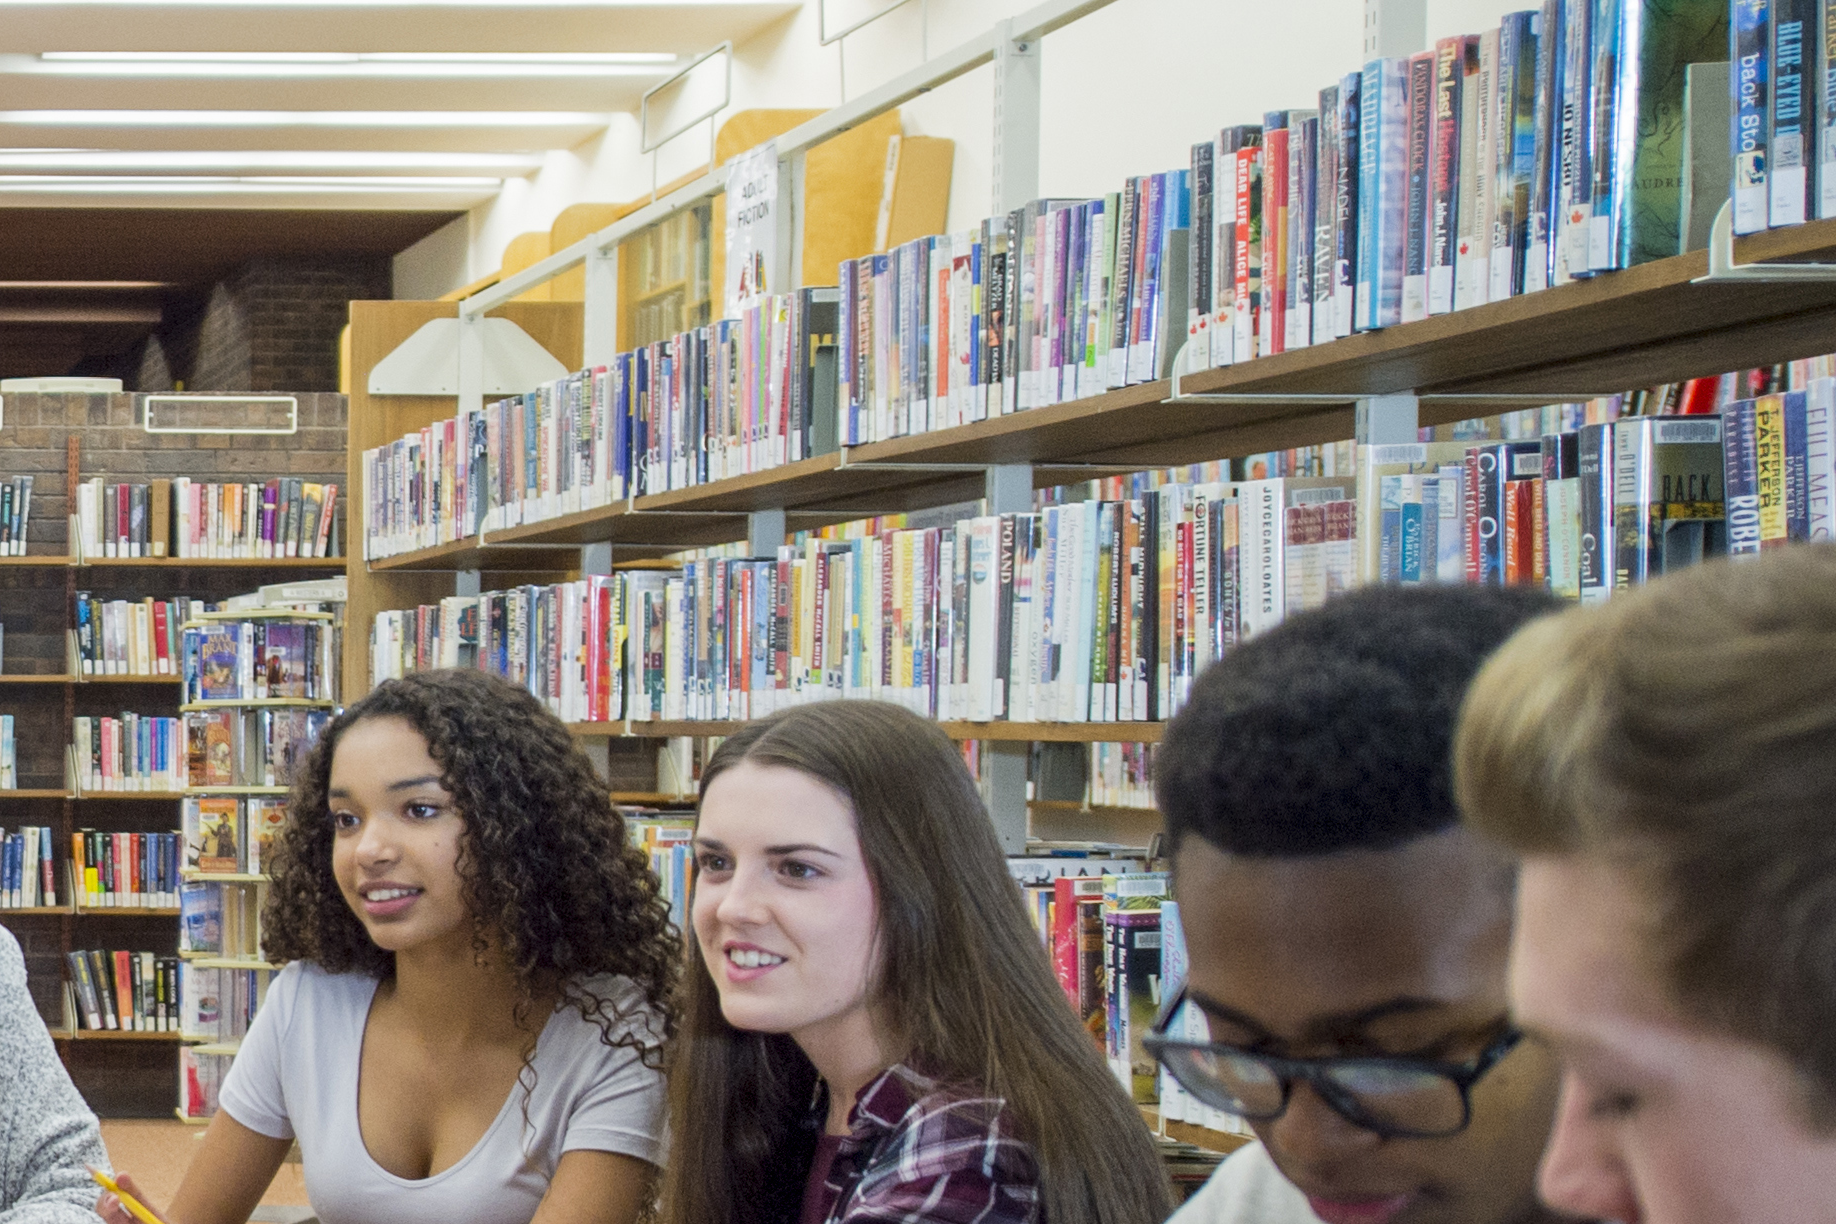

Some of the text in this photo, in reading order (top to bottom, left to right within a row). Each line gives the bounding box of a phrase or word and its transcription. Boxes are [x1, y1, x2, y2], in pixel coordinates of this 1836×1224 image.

[1439, 44, 1455, 78] The
[1741, 52, 1760, 108] back
[1776, 21, 1802, 120] BLUE-EYED
[1438, 81, 1453, 120] Last
[1412, 130, 1425, 170] CLOCK
[1436, 120, 1450, 192] Hostage
[742, 175, 769, 199] ADULT
[1237, 159, 1247, 194] DEAR
[738, 200, 770, 228] FICTION
[1237, 198, 1247, 226] LIFE
[1409, 186, 1421, 223] JOHN
[1436, 200, 1447, 226] John
[1436, 226, 1446, 236] J.
[1117, 226, 1132, 298] MICHAELS
[1237, 240, 1247, 278] ALICE
[1477, 453, 1497, 508] CAROL
[1619, 454, 1636, 495] O'DELL
[1758, 411, 1770, 509] PARKER
[1771, 425, 1781, 507] JEFFERSON
[1195, 495, 1206, 564] FORTUNE
[1464, 455, 1478, 572] Carol O'Connell
[1000, 521, 1013, 583] POLAND
[1405, 518, 1417, 572] O'BRIAN
[1582, 533, 1597, 584] Coal
